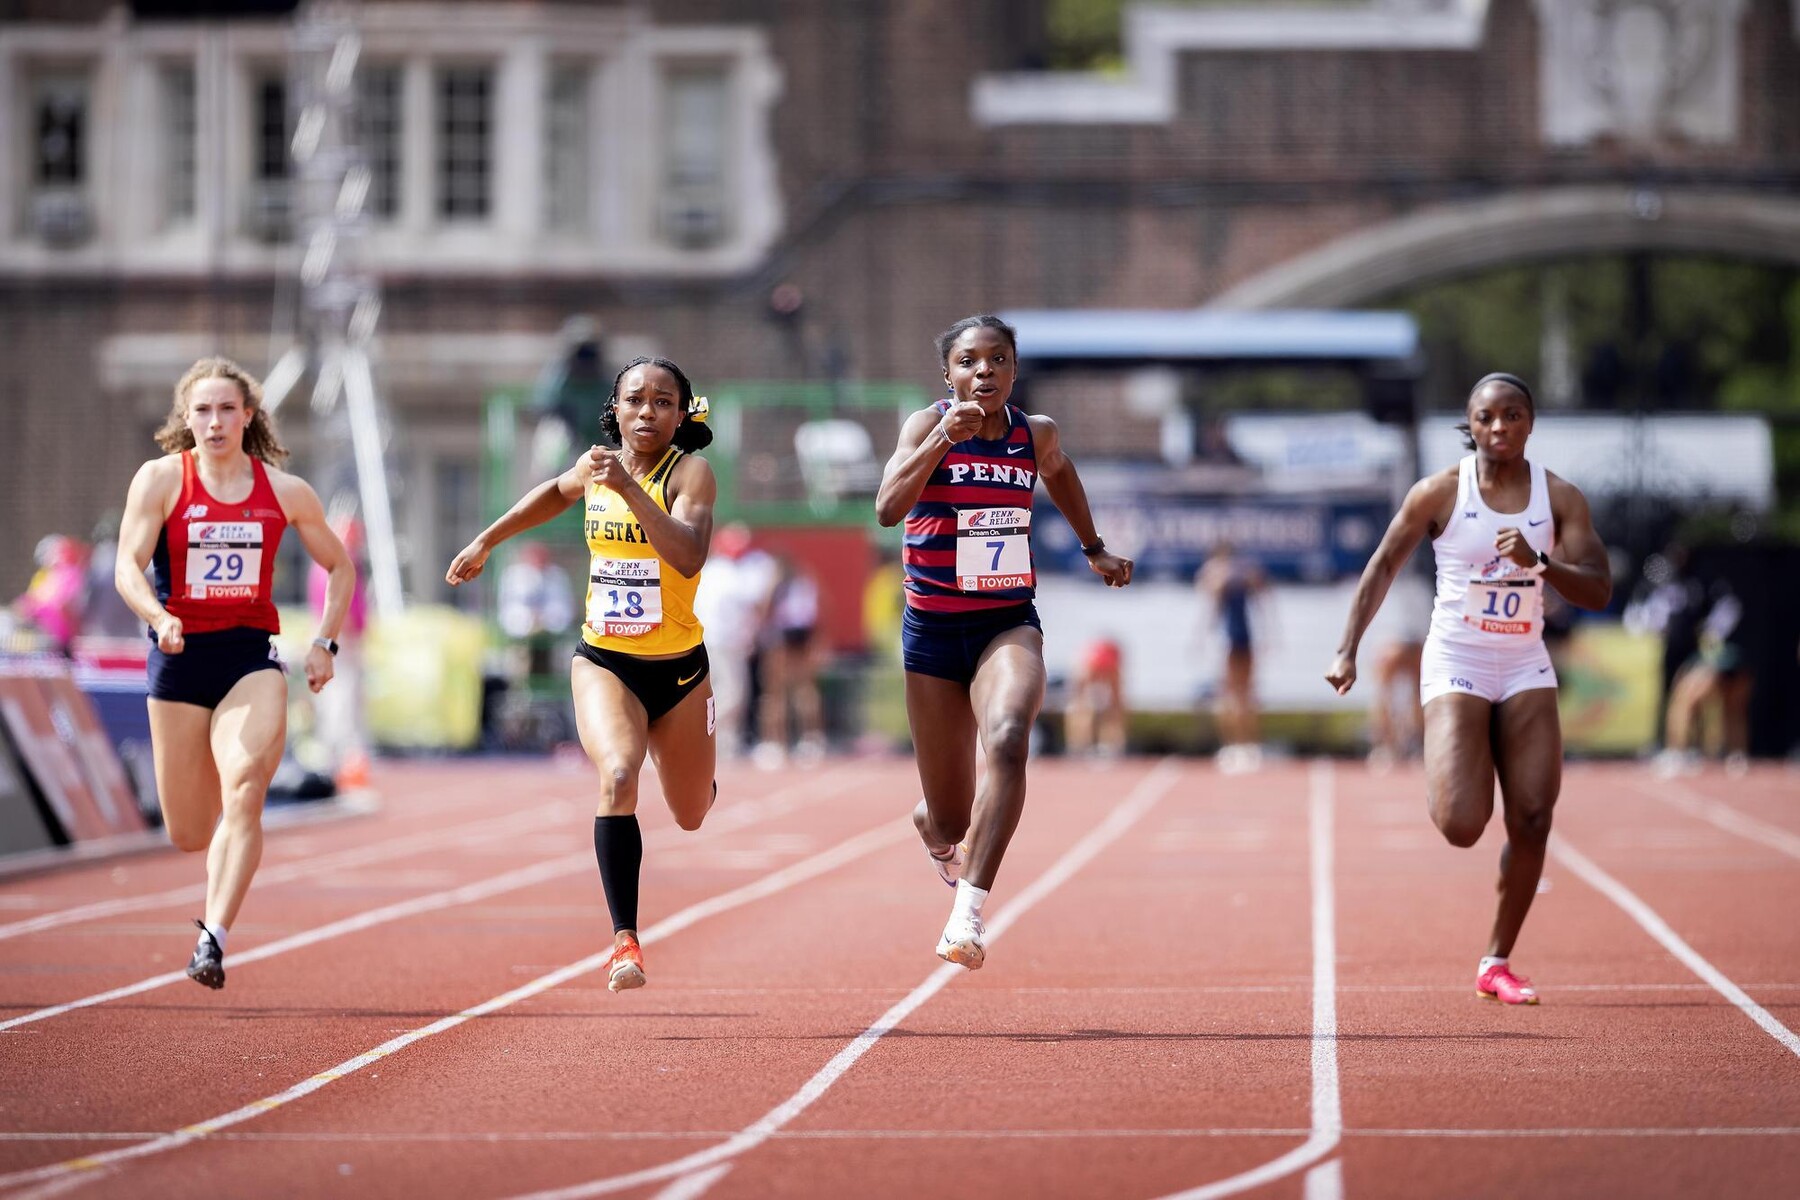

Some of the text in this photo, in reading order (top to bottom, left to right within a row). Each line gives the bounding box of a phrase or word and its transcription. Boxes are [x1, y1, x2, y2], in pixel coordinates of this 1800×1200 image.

[949, 463, 1033, 489] PENN
[989, 517, 1020, 525] RELAYS
[586, 520, 648, 544] PP STAT
[986, 541, 1005, 571] 7
[204, 554, 244, 581] 29
[617, 561, 640, 569] PENN
[615, 568, 649, 576] RELAYS
[980, 577, 1026, 588] TOYOTA
[208, 586, 253, 598] TOYOTA
[604, 590, 645, 618] 18
[1482, 590, 1521, 619] 10
[608, 624, 652, 634] TOYOTA
[1484, 621, 1526, 633] TOYOTA
